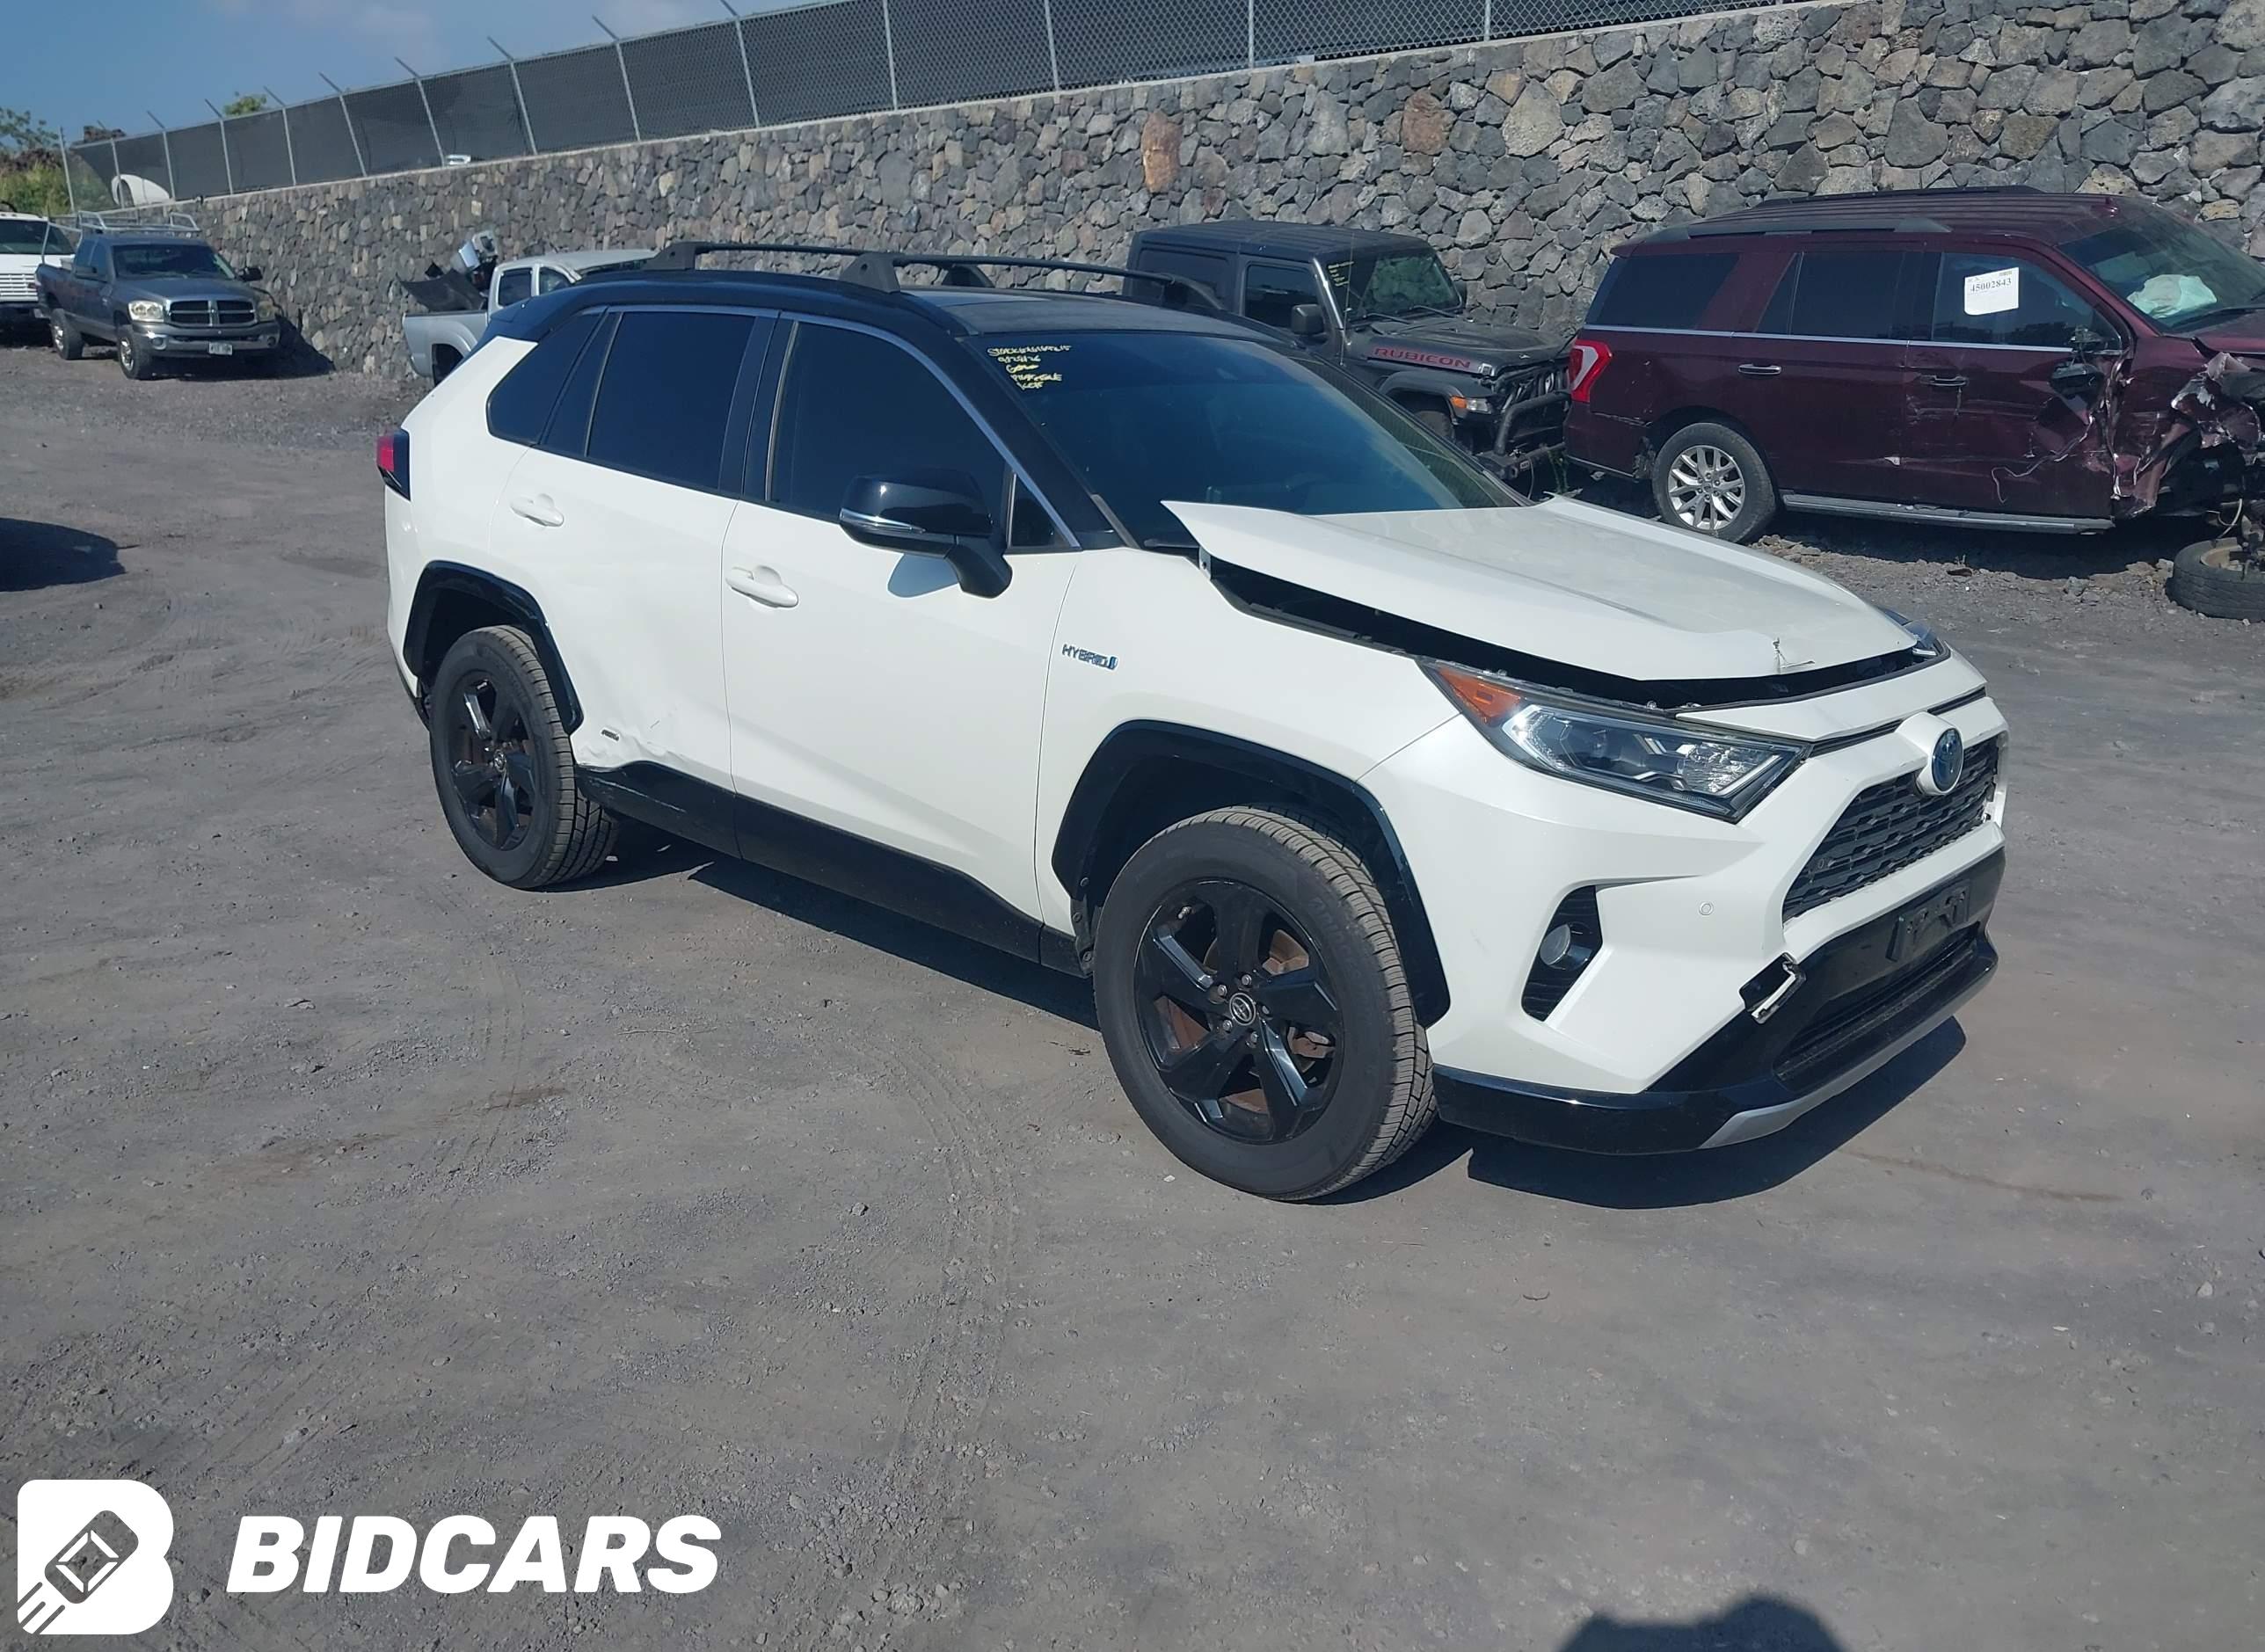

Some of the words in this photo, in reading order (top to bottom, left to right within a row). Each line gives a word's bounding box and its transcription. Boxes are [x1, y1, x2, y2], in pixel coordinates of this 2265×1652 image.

[1970, 277, 2012, 293] 45002843
[1374, 347, 1471, 368] RUBICON
[1061, 644, 1109, 669] HYBRID
